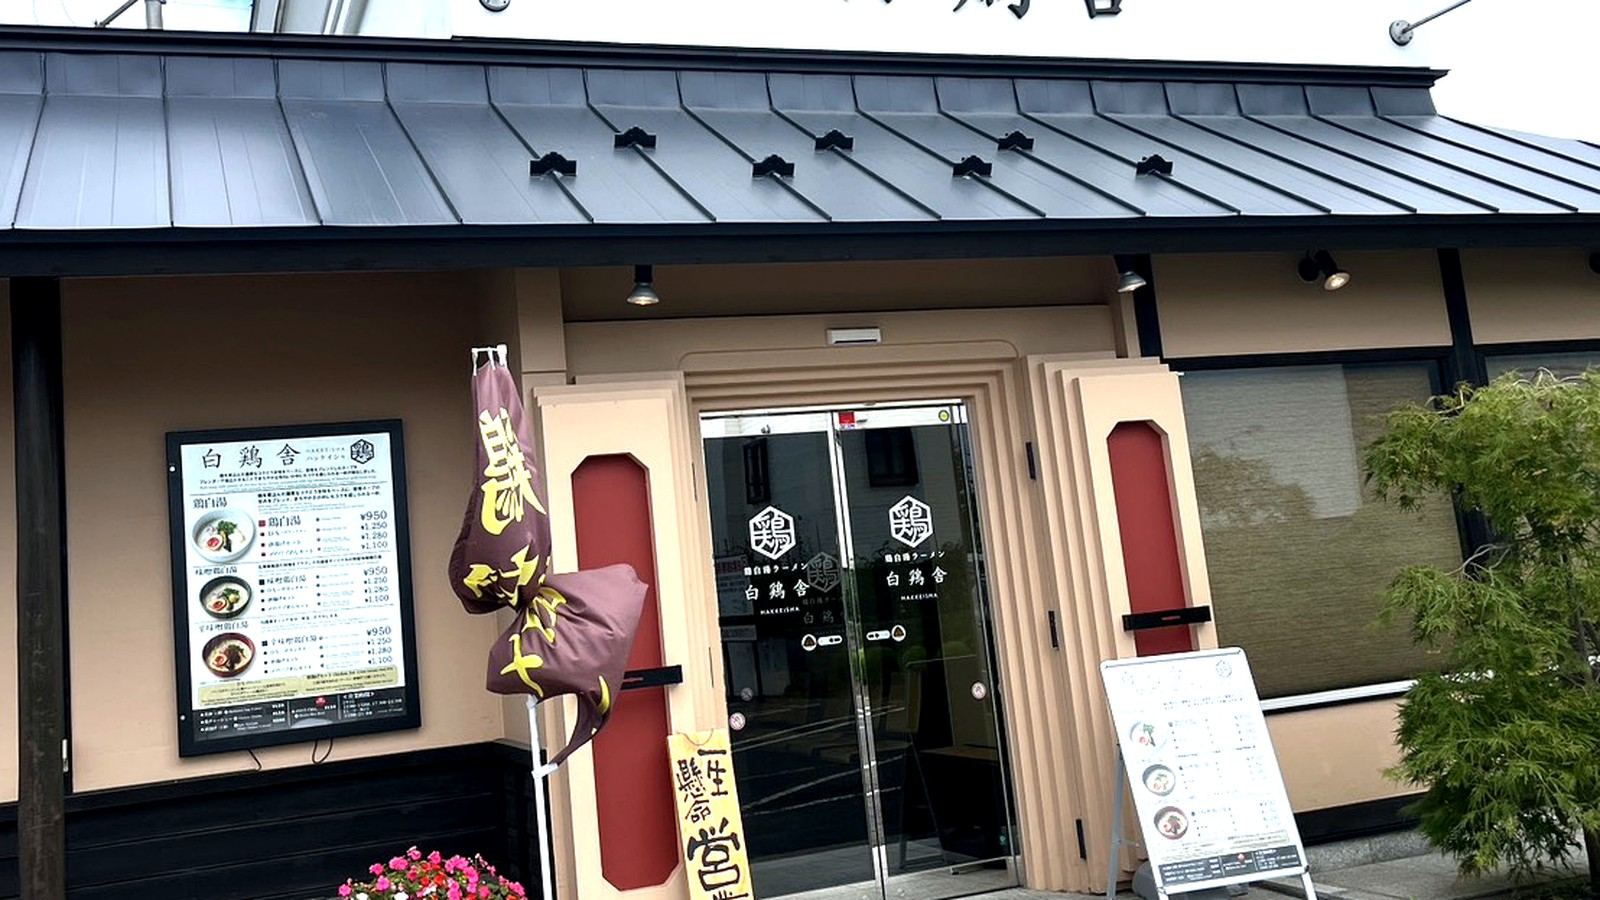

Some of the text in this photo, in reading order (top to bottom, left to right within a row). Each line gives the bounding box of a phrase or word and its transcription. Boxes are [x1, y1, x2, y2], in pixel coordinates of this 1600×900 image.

[202, 443, 300, 468] 白鶏舎
[360, 510, 387, 520] ¥950
[886, 566, 947, 587] 白鶏舎
[745, 579, 810, 600] 白鶏舎
[697, 749, 728, 796] 一生
[687, 817, 749, 900] 営
